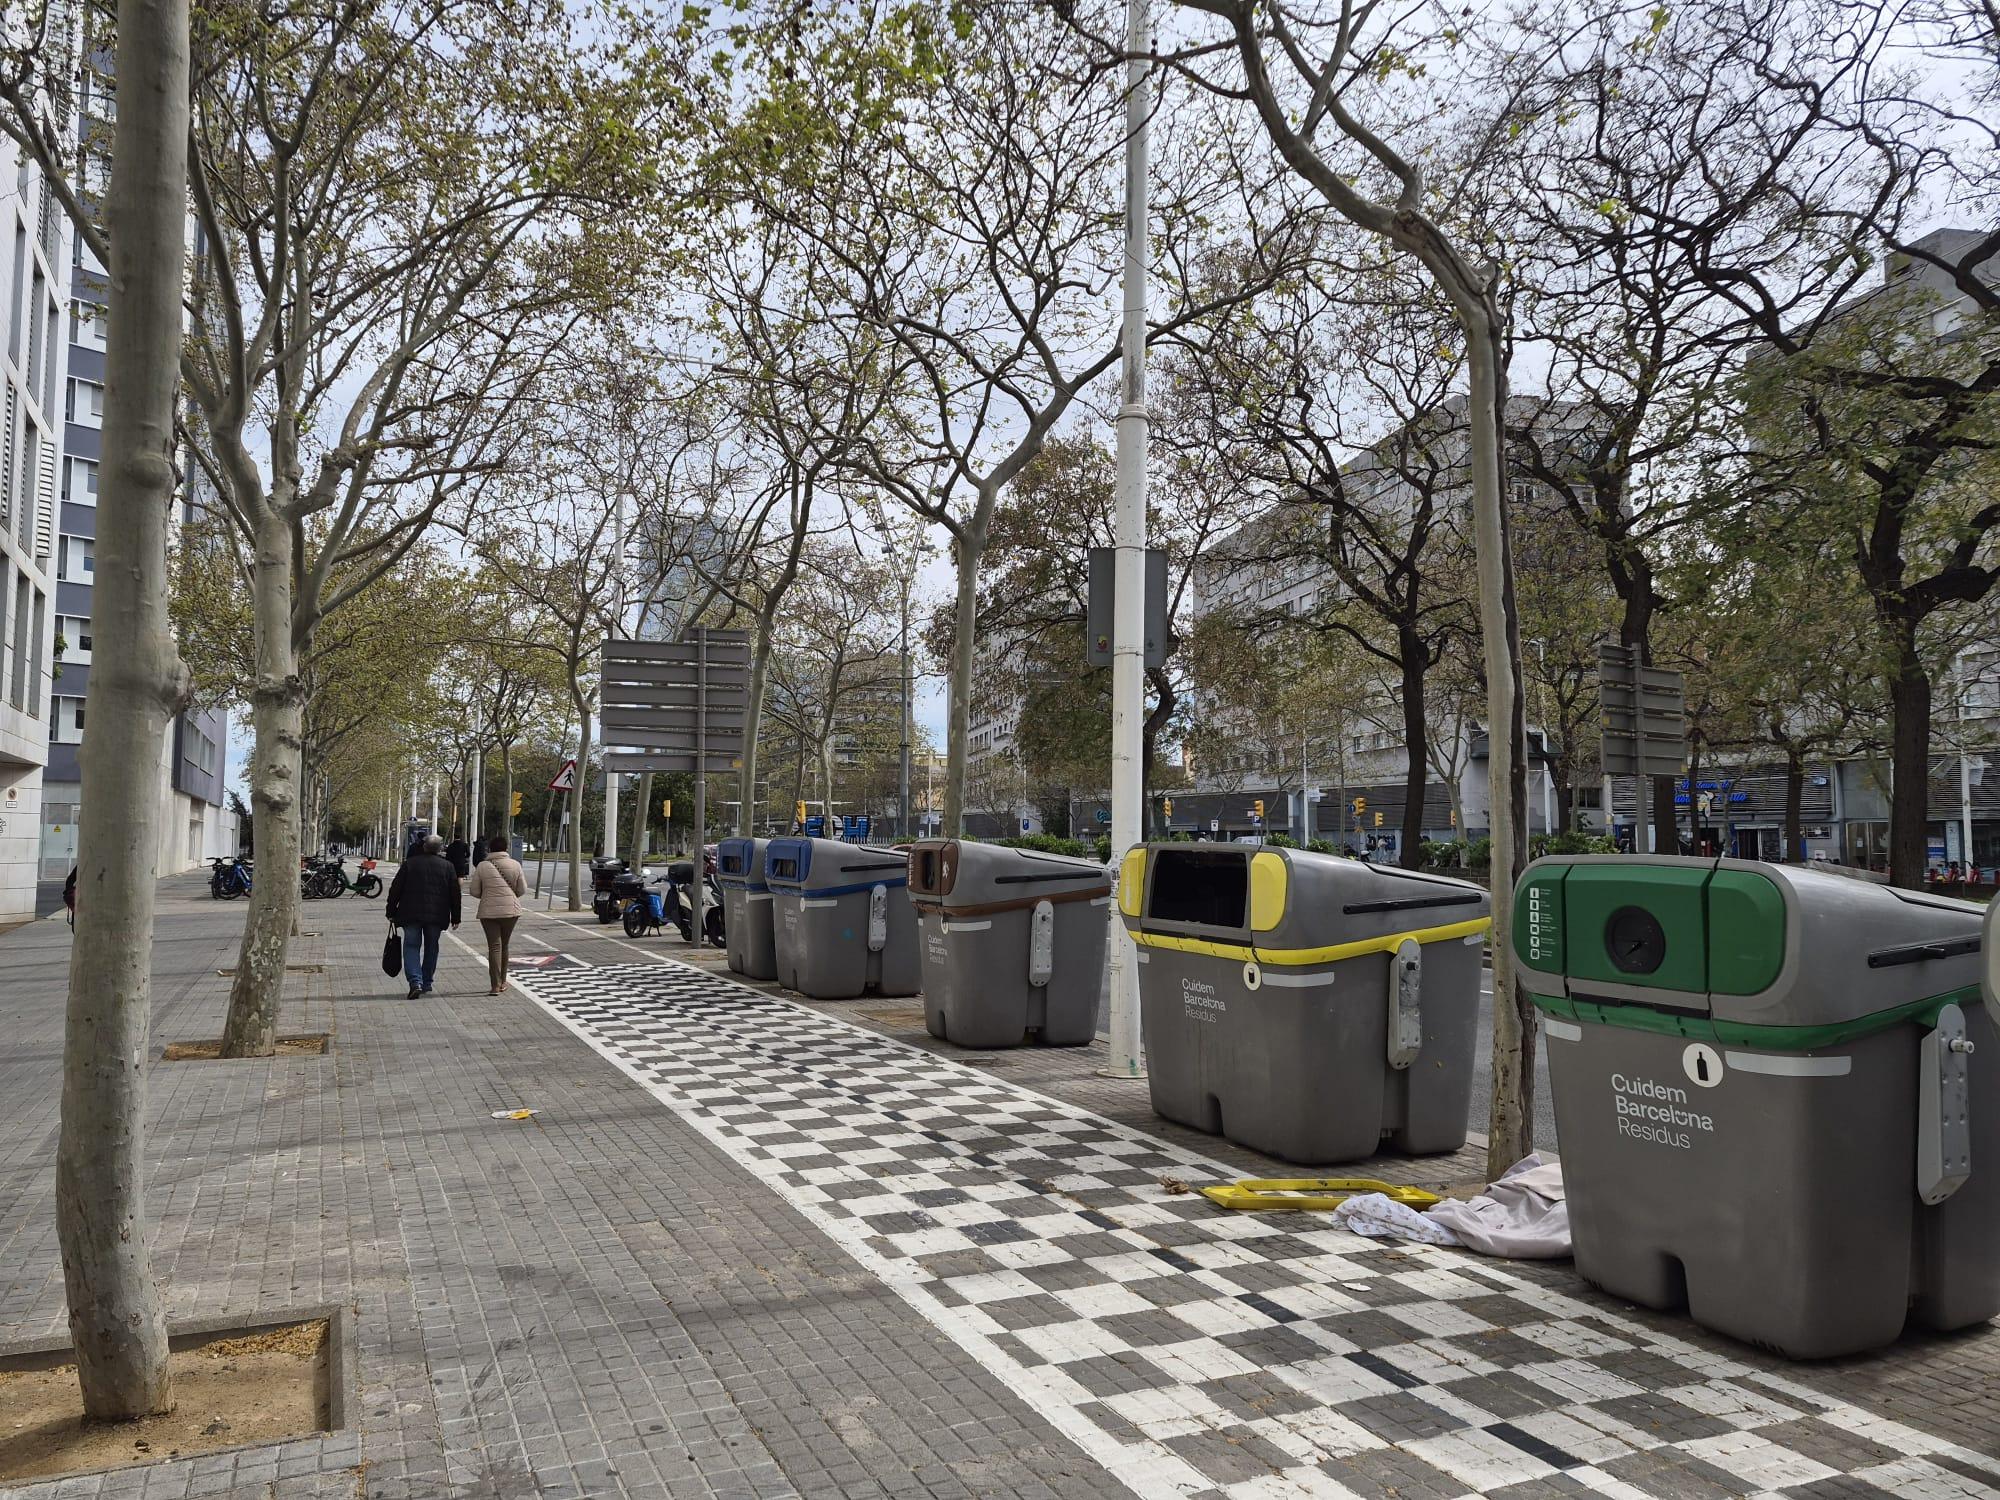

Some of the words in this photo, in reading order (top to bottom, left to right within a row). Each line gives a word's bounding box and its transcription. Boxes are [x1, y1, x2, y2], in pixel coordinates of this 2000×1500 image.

[1182, 978, 1215, 995] Cuidem
[1183, 991, 1226, 1011] Barcelona
[1185, 1004, 1217, 1023] Residus
[1611, 1073, 1687, 1104] Cuidem
[1615, 1094, 1714, 1132] Barcelona
[1617, 1116, 1691, 1149] Residus
